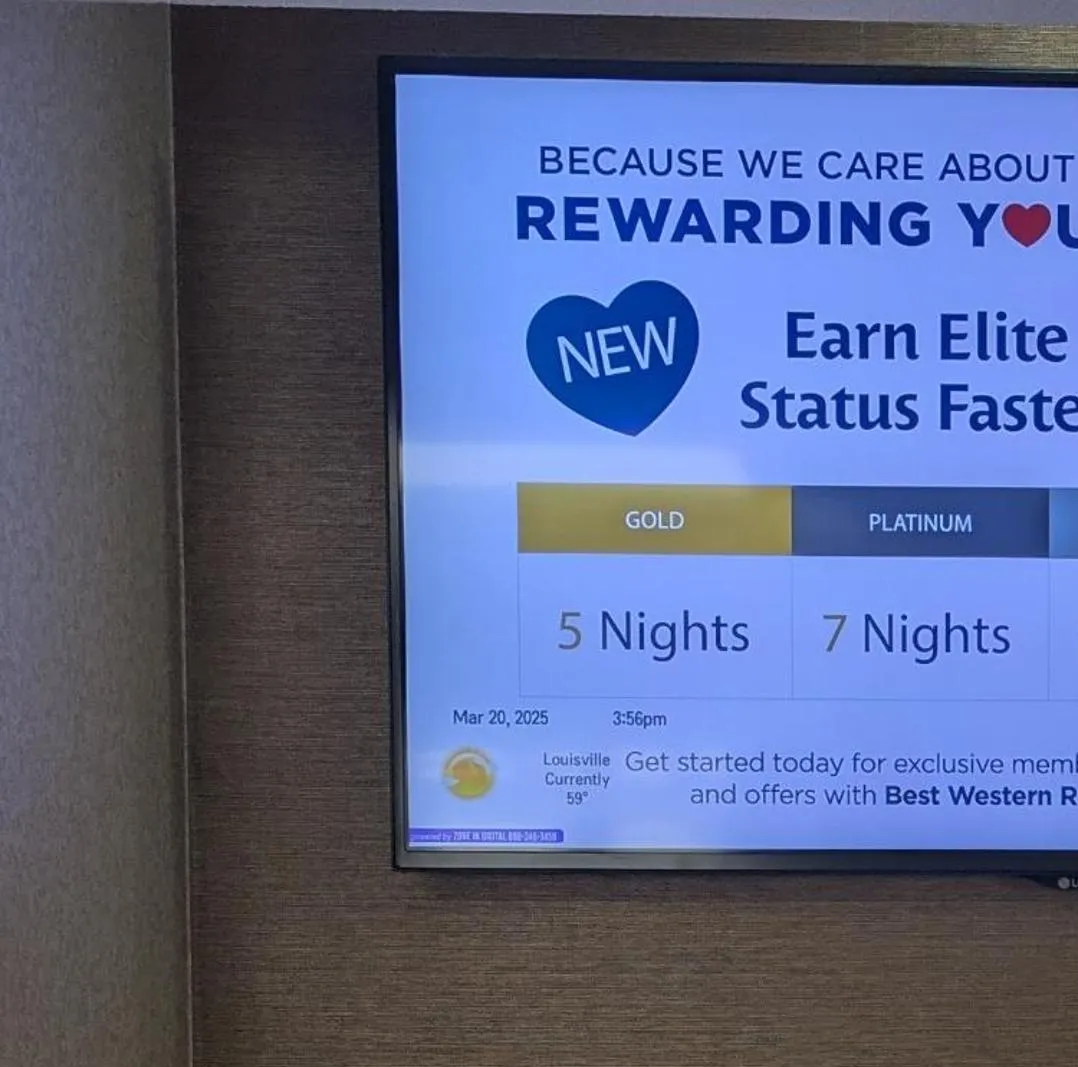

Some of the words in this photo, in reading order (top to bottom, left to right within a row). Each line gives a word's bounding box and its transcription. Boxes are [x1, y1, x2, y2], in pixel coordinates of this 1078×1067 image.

[540, 146, 723, 177] BECAUSE
[738, 150, 802, 178] WE
[818, 151, 924, 180] CARE
[939, 153, 1075, 182] ABOUT
[516, 196, 930, 246] REWARDING
[787, 312, 919, 360] Earn
[941, 311, 1068, 362] Elite
[557, 317, 676, 383] NEW
[741, 381, 919, 430] Status
[626, 511, 684, 529] GOLD
[870, 514, 972, 532] PLATINUM
[558, 612, 581, 649] 5
[602, 610, 749, 661] Nights
[823, 615, 847, 652] 7
[865, 612, 1010, 664] Nights
[454, 710, 484, 724] Mar
[489, 709, 510, 727] 20,
[515, 710, 548, 725] 2025
[613, 711, 666, 729] 3:56pm
[544, 752, 610, 766] Louisville
[626, 751, 669, 771] Get
[678, 751, 764, 772] started
[773, 752, 844, 776] today
[852, 752, 886, 773] for
[894, 753, 1003, 774] exclusive
[545, 772, 610, 788] Currently
[691, 783, 736, 804] and
[745, 783, 815, 804] offers
[825, 784, 876, 805] with
[886, 786, 939, 805] Best
[948, 786, 1051, 805] Western
